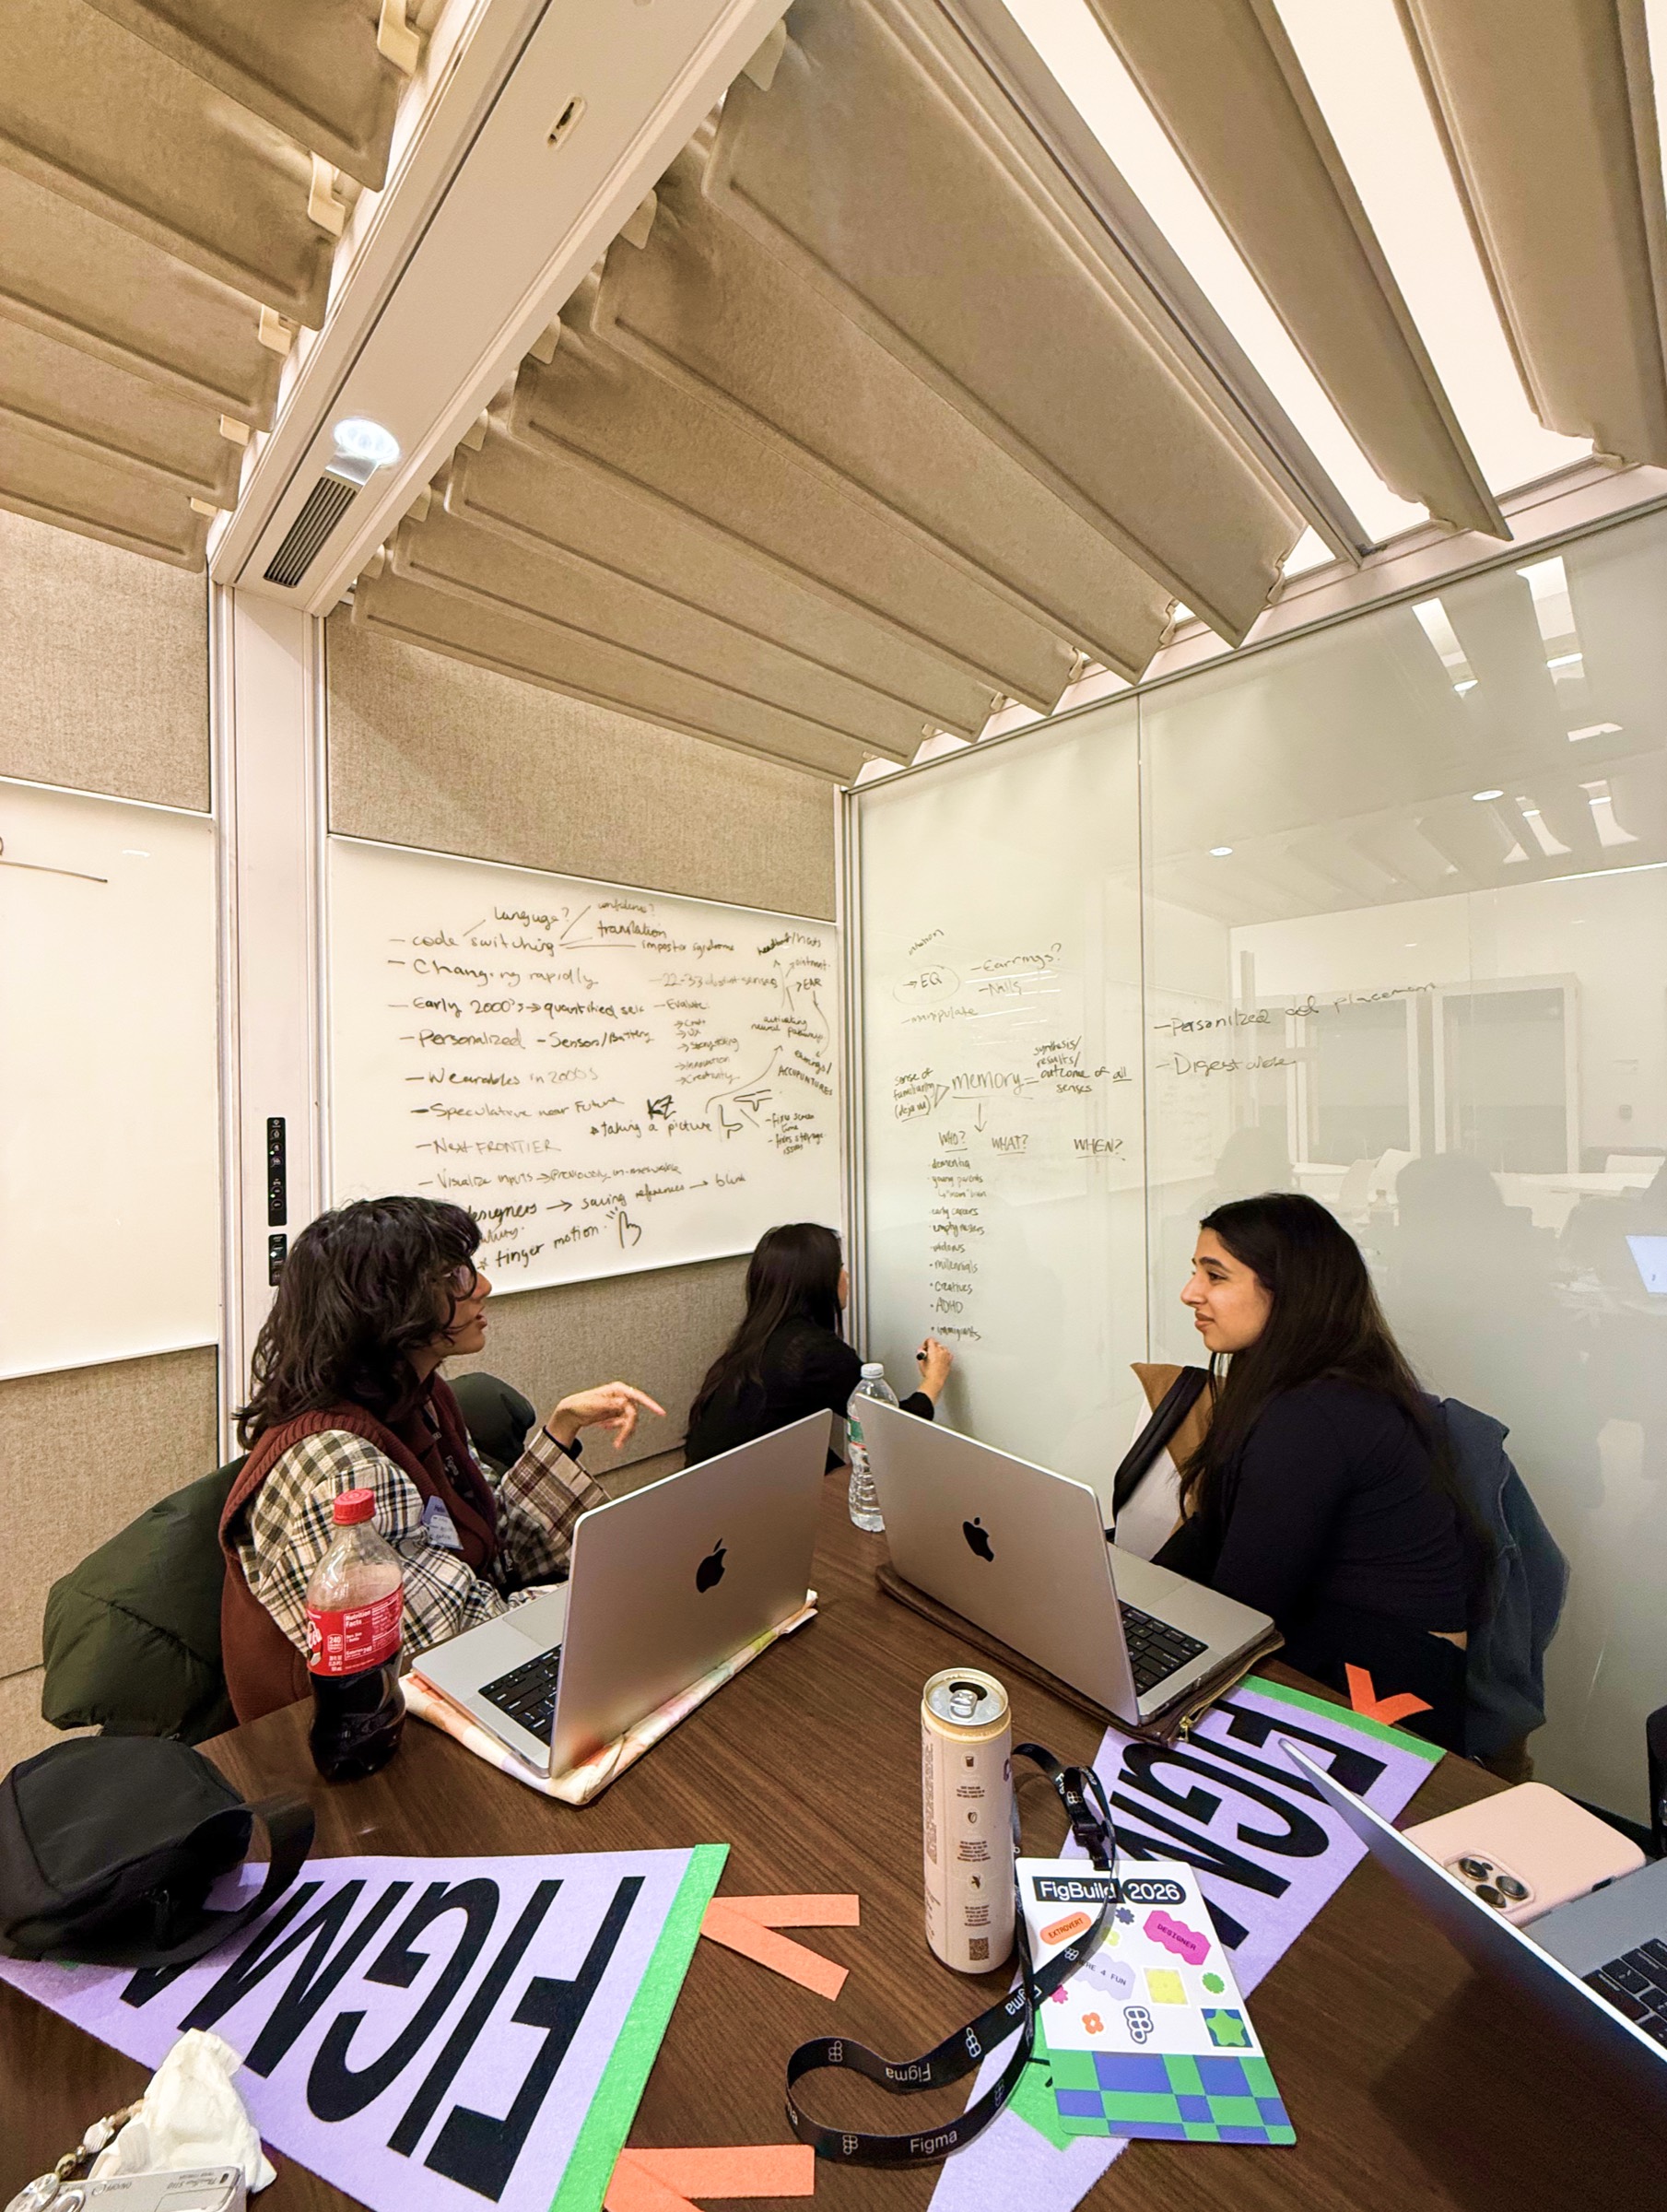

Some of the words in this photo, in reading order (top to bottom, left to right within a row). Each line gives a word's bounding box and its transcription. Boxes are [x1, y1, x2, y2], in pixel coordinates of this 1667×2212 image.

[412, 930, 459, 947] code
[471, 933, 555, 957] switching
[529, 967, 599, 990] rapidly
[804, 977, 824, 992] EAR
[921, 971, 943, 988] EQ
[413, 996, 463, 1018] Early
[419, 1028, 526, 1049] Personalized
[668, 1119, 713, 1137] picture
[477, 1138, 562, 1154] FRONTIER
[938, 1130, 967, 1147] WHO?
[991, 1134, 1029, 1150] WHAT?
[1073, 1137, 1124, 1154] WHEN?
[935, 1296, 964, 1314] ADHD
[1040, 1880, 1116, 1902] FigBuild
[1129, 1883, 1180, 1900] 2026
[1048, 1917, 1085, 1939] EXTROVERT
[1156, 1923, 1198, 1952] DESIGNER
[1109, 1972, 1127, 1986] FUN
[1004, 1984, 1042, 2017] Fgma
[885, 2063, 932, 2083] Figma
[910, 2130, 957, 2154] Figma
